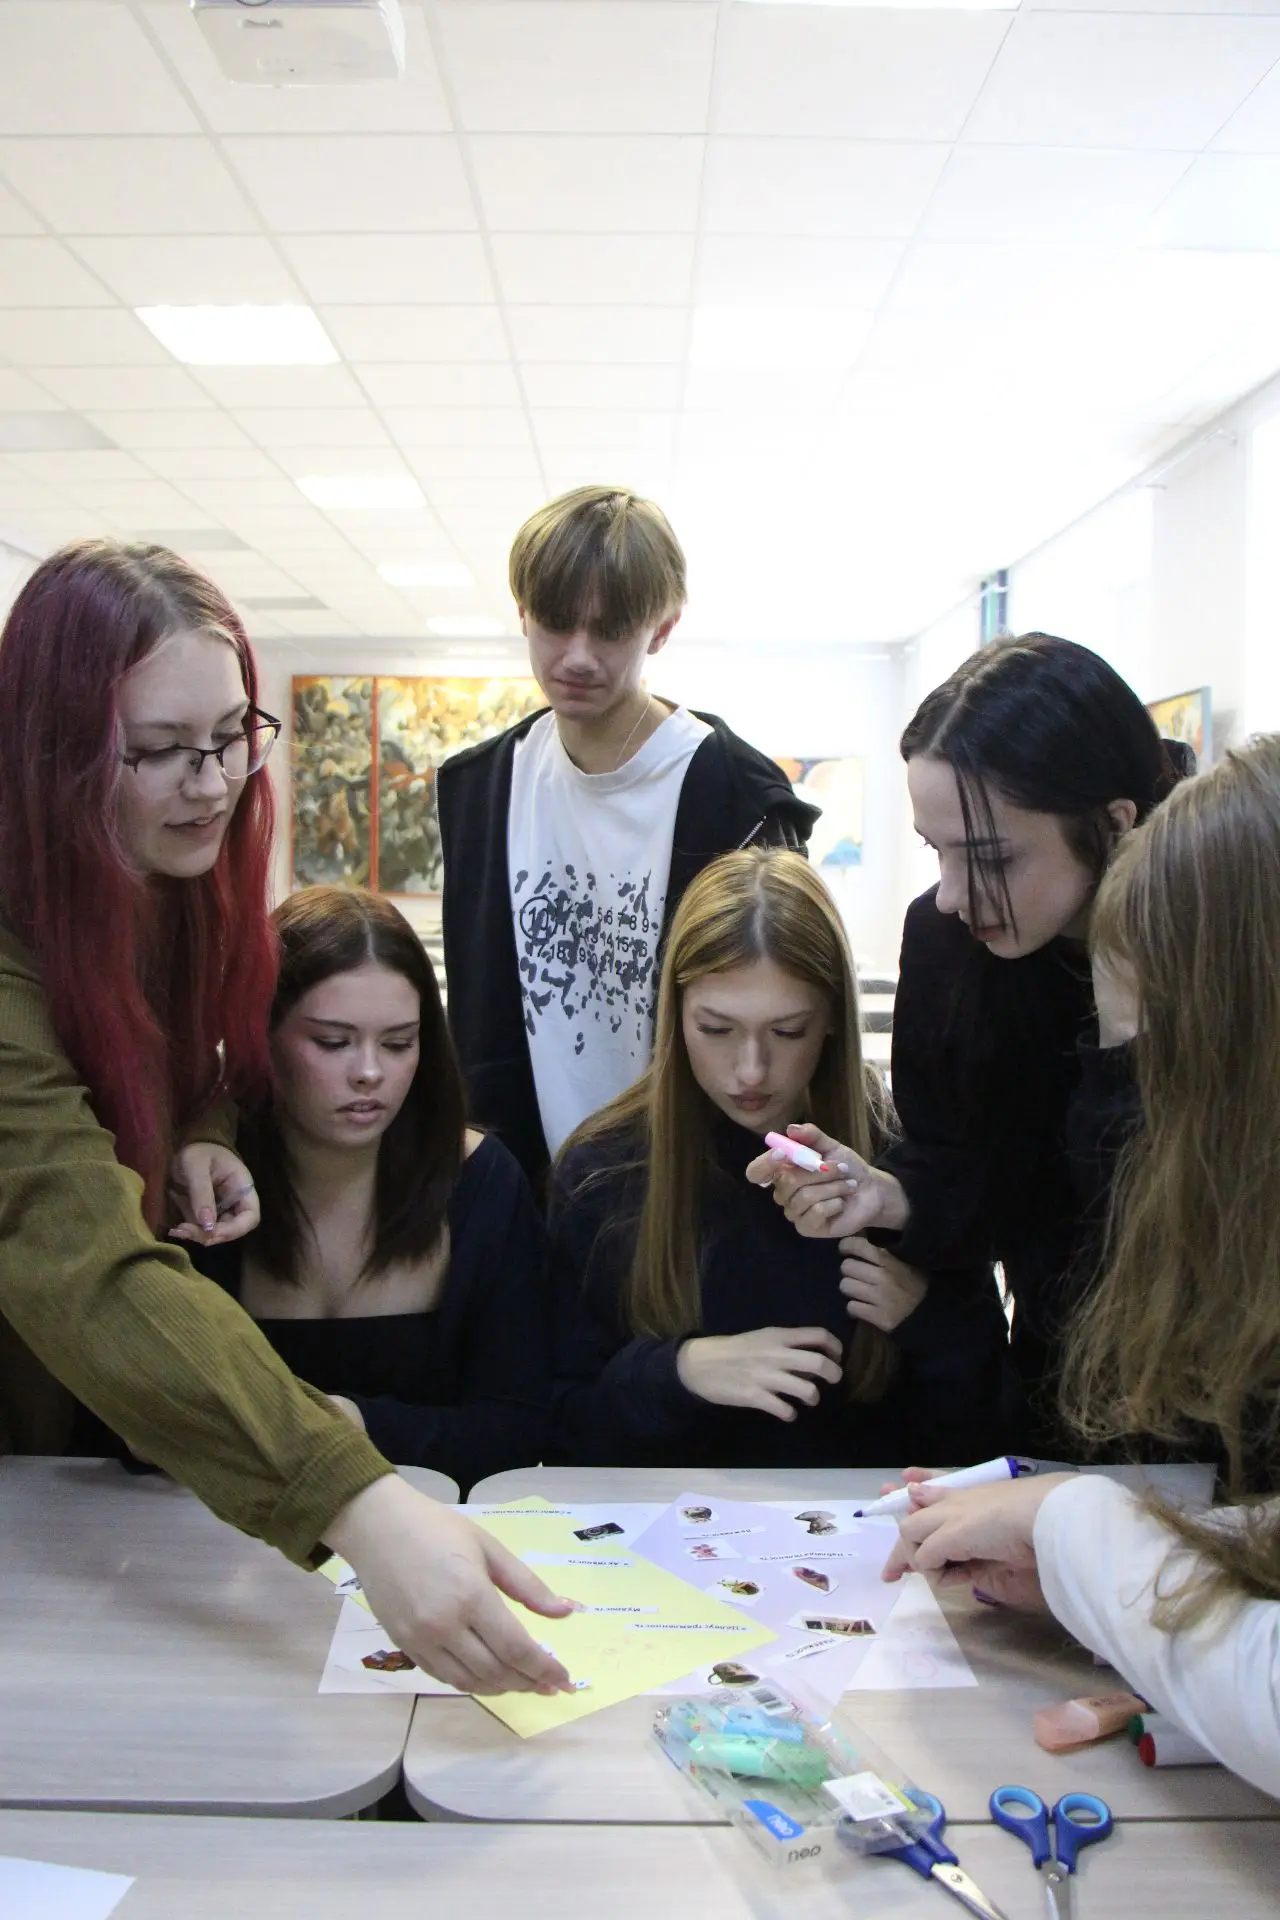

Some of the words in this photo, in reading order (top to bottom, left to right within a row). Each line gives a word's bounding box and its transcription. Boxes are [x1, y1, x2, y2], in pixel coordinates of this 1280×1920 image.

[528, 906, 549, 931] 10
[615, 934, 630, 953] 15
[604, 909, 613, 926] 6
[628, 914, 638, 931] 8
[641, 917, 650, 933] 9
[550, 943, 566, 960] 18
